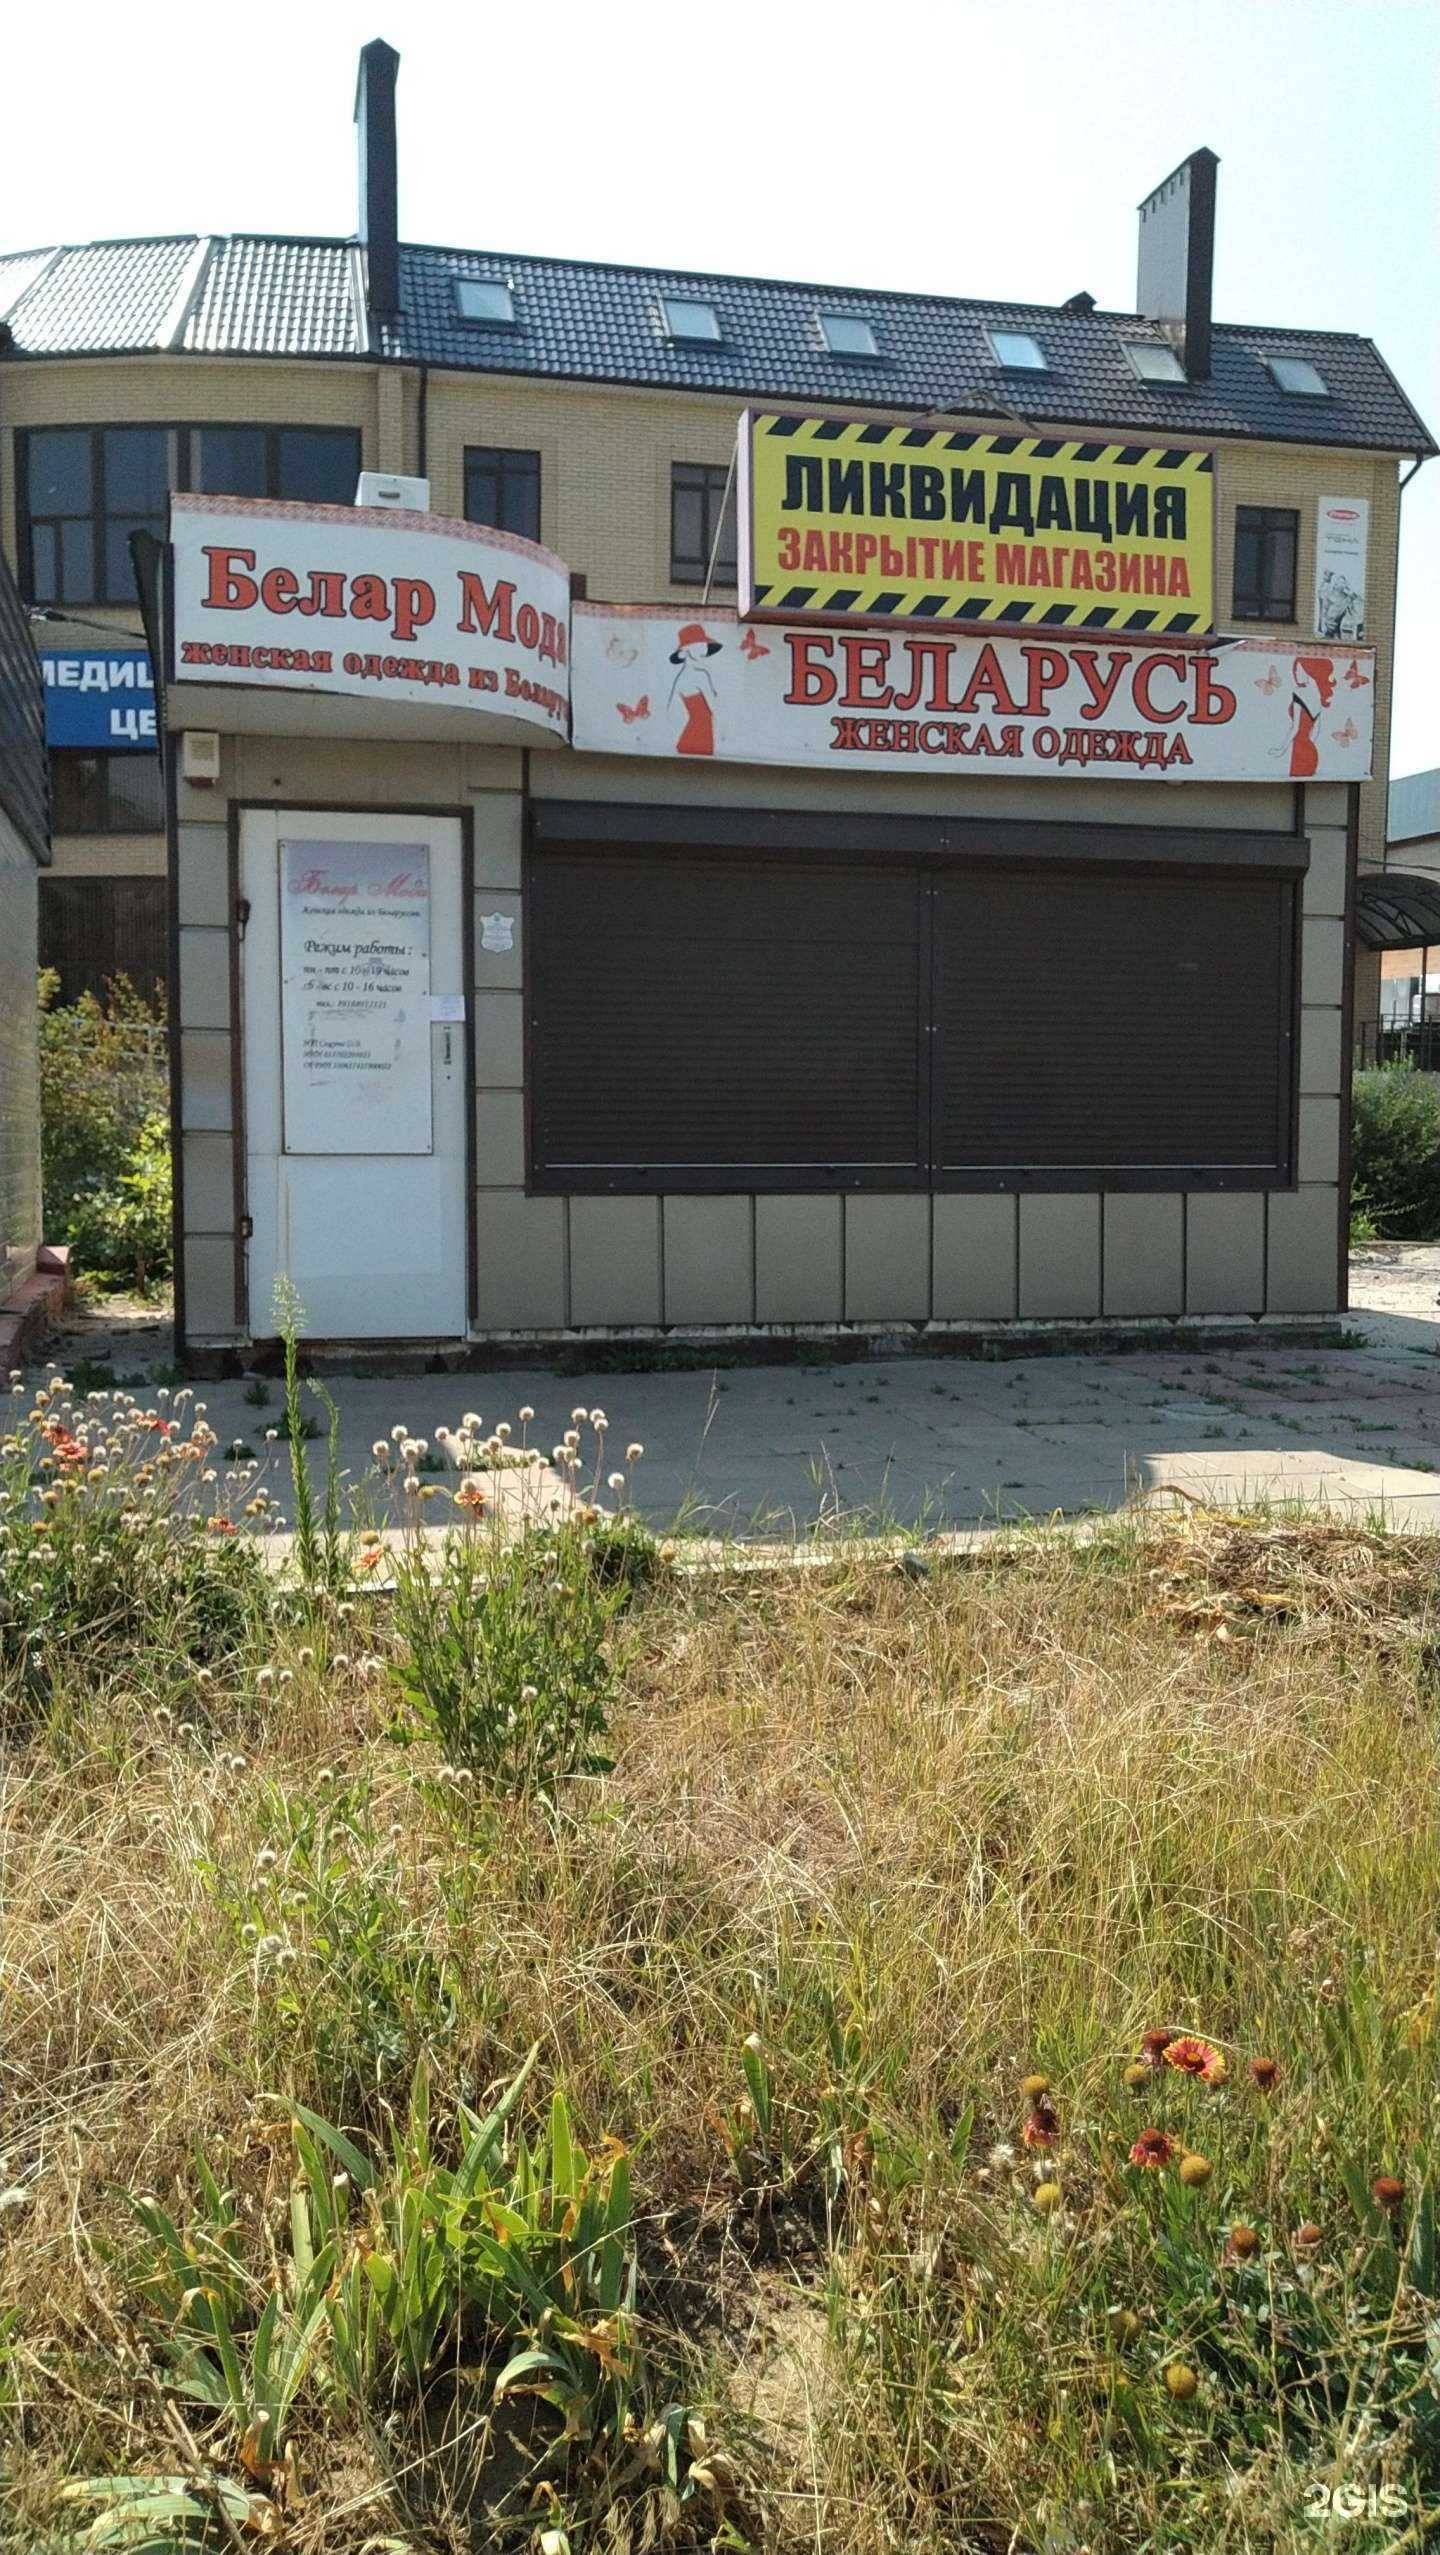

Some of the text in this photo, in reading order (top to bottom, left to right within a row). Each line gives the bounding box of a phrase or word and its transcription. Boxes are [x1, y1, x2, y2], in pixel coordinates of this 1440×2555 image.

[782, 455, 1187, 543] ЛИКВИДАЦИЯ
[777, 527, 1191, 598] ЗАКРЫТИЕ МАГАЗИНА
[201, 546, 567, 668] Белар Мода
[181, 641, 332, 673] женская
[343, 651, 460, 688] одежда
[468, 667, 499, 692] из
[784, 633, 1238, 725] БЕЛАРУСЬ
[830, 717, 1193, 770] ЖЕНСКАЯ ОДЕЖДА
[303, 940, 352, 957] Режим
[342, 981, 354, 992] 10
[362, 982, 375, 992] 16
